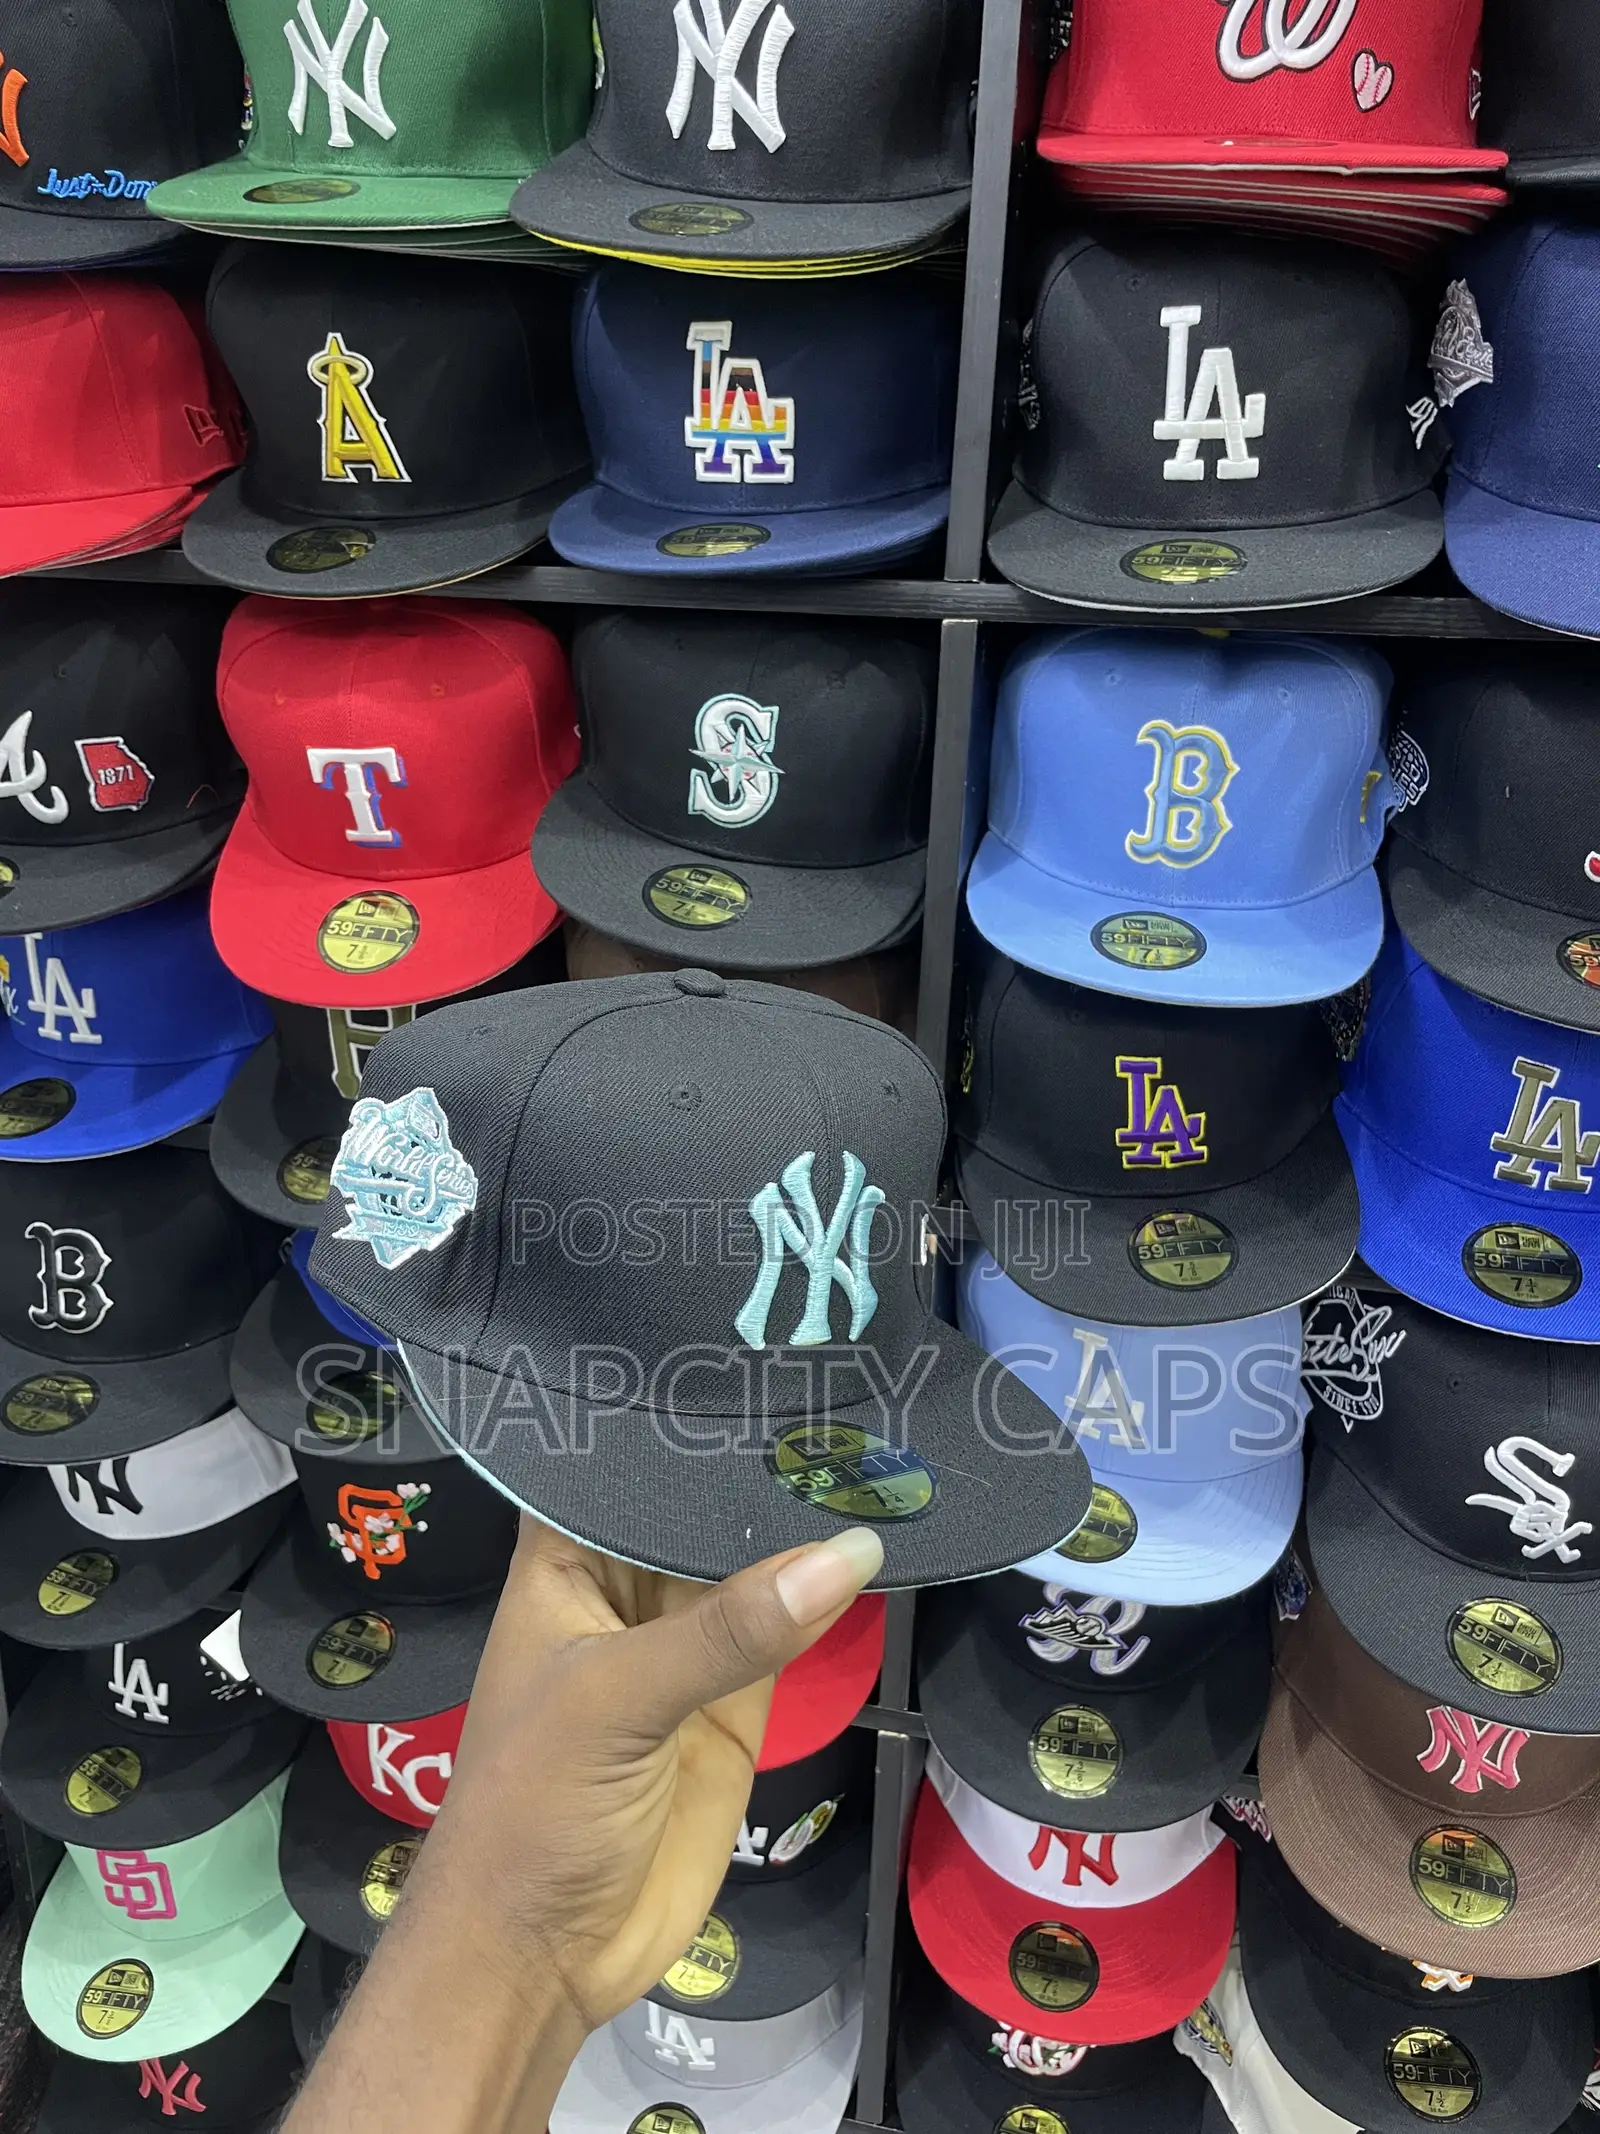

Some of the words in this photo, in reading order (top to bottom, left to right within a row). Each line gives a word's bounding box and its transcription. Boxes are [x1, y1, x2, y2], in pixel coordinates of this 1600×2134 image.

[307, 332, 412, 483] A
[684, 321, 795, 483] LA
[1154, 305, 1267, 481] LA
[98, 764, 135, 786] 1871
[306, 747, 407, 848] T
[688, 693, 785, 829] S
[1125, 719, 1240, 869] B
[326, 920, 412, 943] 59FIFTY
[655, 879, 742, 911] 59FIFTY
[1101, 931, 1191, 948] 59FIFTY
[26, 932, 102, 1043] LA
[1115, 1056, 1207, 1169] LA
[1489, 1056, 1600, 1194] LA
[25, 1221, 114, 1334] B
[734, 1150, 886, 1350] NY
[1138, 1239, 1225, 1259] 59FIFTY
[1474, 1253, 1566, 1275] 59FIFTY
[1064, 1328, 1144, 1446] LA
[790, 1450, 911, 1492] 59FIFTY
[108, 1641, 170, 1725] LA
[1457, 1615, 1554, 1674] 59FIFTY
[367, 1723, 453, 1815] KC
[1037, 1736, 1118, 1760] 59FIFTY
[1418, 1857, 1510, 1894] 59FIFTY
[84, 1989, 145, 2009] 59FIFTY
[645, 2000, 717, 2070] LA
[1393, 2062, 1472, 2086] 59FIFTY
